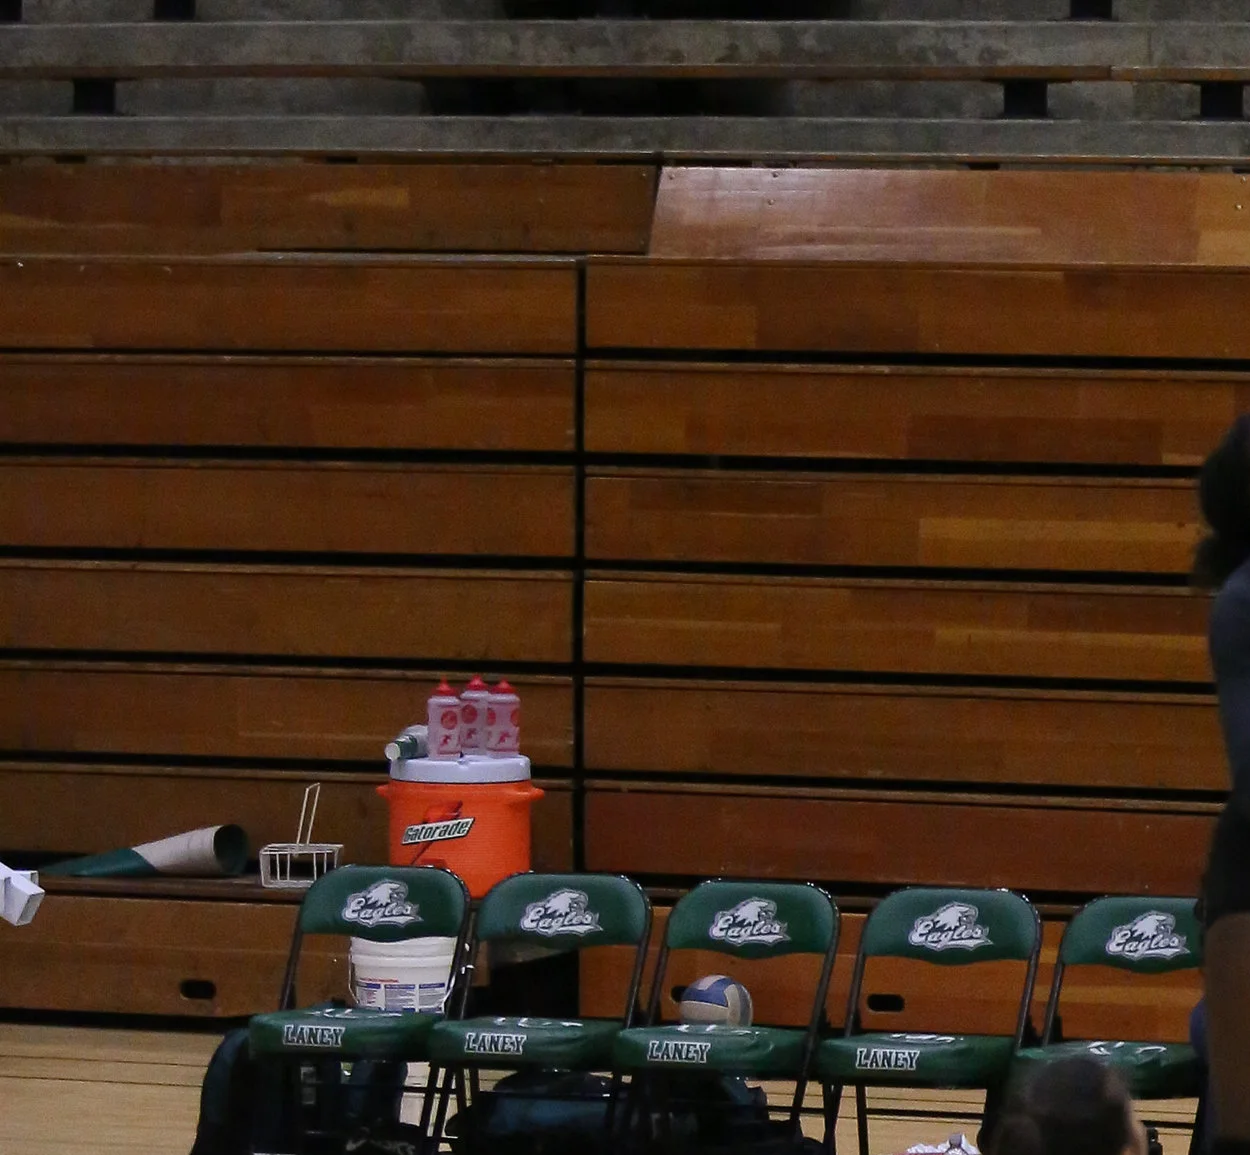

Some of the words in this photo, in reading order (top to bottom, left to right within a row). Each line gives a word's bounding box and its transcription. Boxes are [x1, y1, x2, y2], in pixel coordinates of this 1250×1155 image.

[403, 820, 470, 842] Gatorade
[344, 898, 412, 924] Eagles
[522, 906, 592, 931] Eagles
[711, 914, 783, 941] Eagles
[911, 918, 985, 946] Eagles
[1108, 929, 1180, 955] Eagles
[283, 1025, 345, 1047] LANEY
[465, 1033, 526, 1055] LANEY
[647, 1041, 711, 1063] LANEY
[856, 1048, 920, 1070] LANEY
